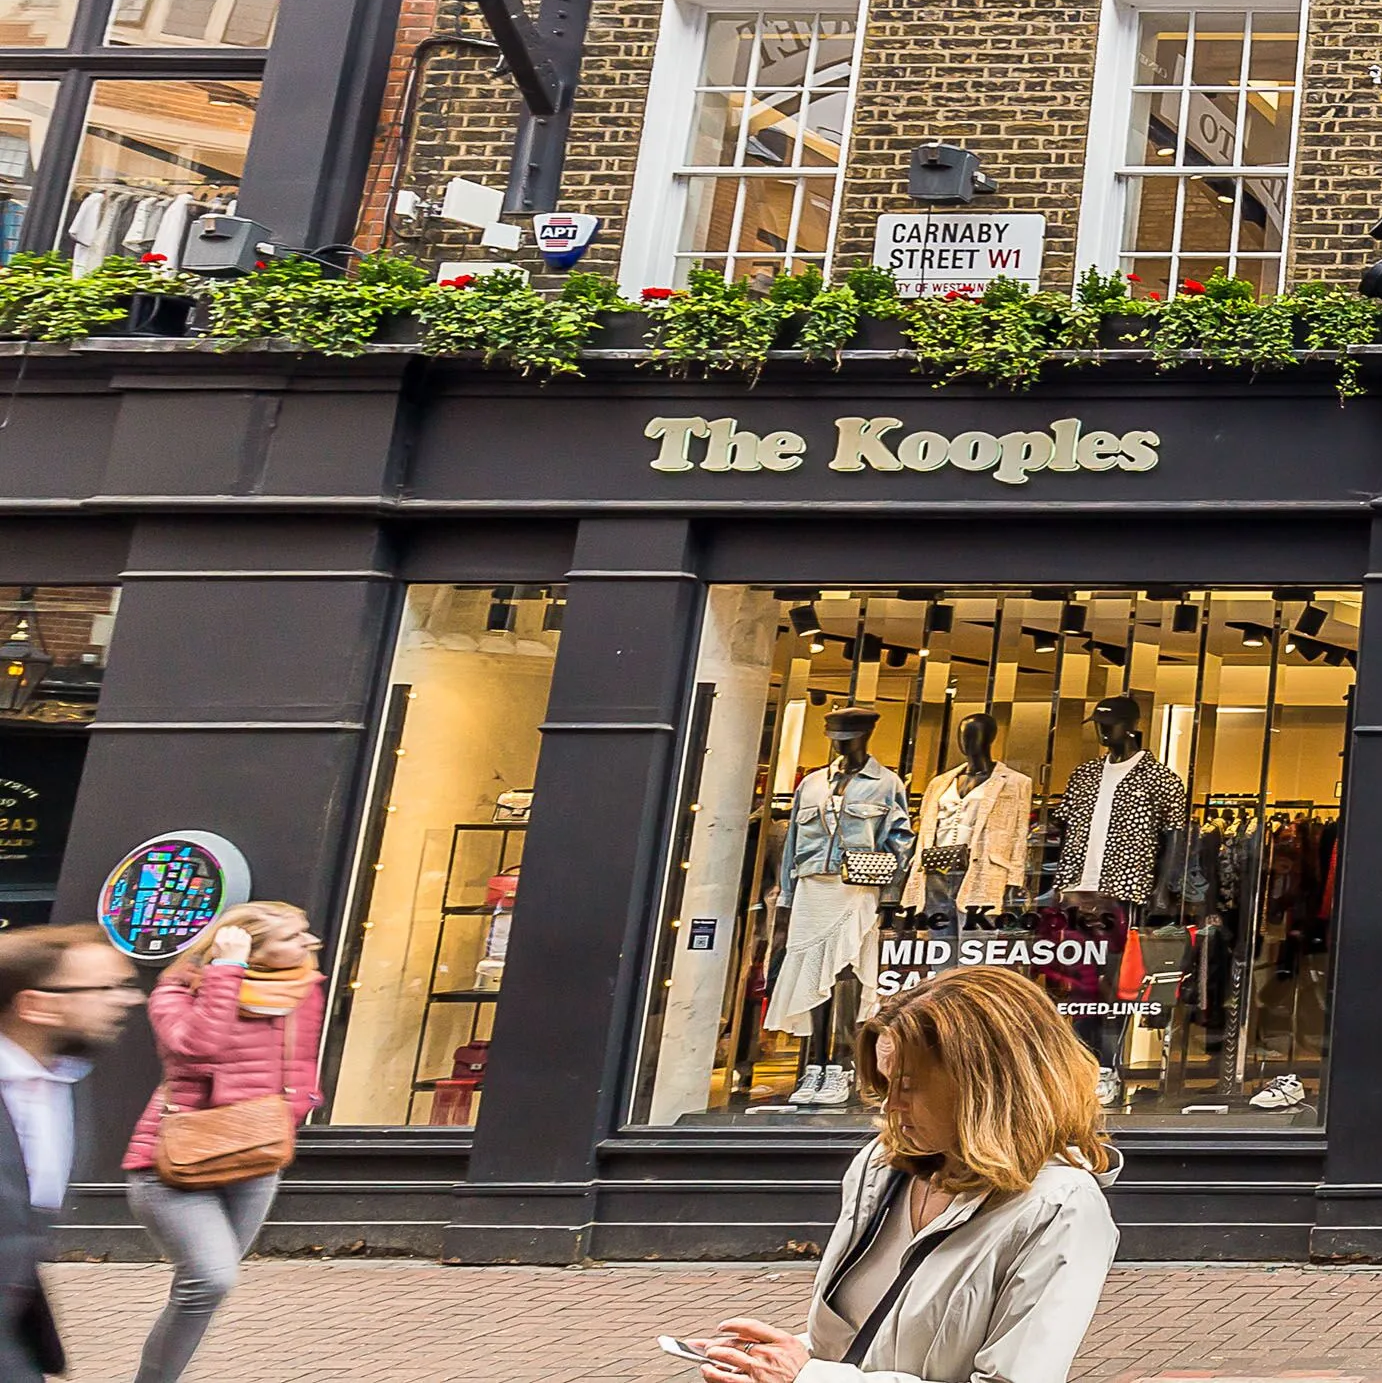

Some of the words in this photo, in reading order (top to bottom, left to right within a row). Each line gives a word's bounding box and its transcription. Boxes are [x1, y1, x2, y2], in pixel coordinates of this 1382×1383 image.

[541, 226, 577, 238] APT
[892, 223, 1009, 243] CARNABY
[889, 249, 980, 269] STREET
[988, 249, 1021, 269] W1
[915, 283, 928, 292] OF
[644, 417, 806, 472] The
[828, 417, 1160, 484] Kooples
[880, 940, 951, 965] MID
[959, 940, 1109, 965] SEASON
[1057, 1002, 1110, 1015] ECTED
[1112, 1002, 1162, 1016] LINES
